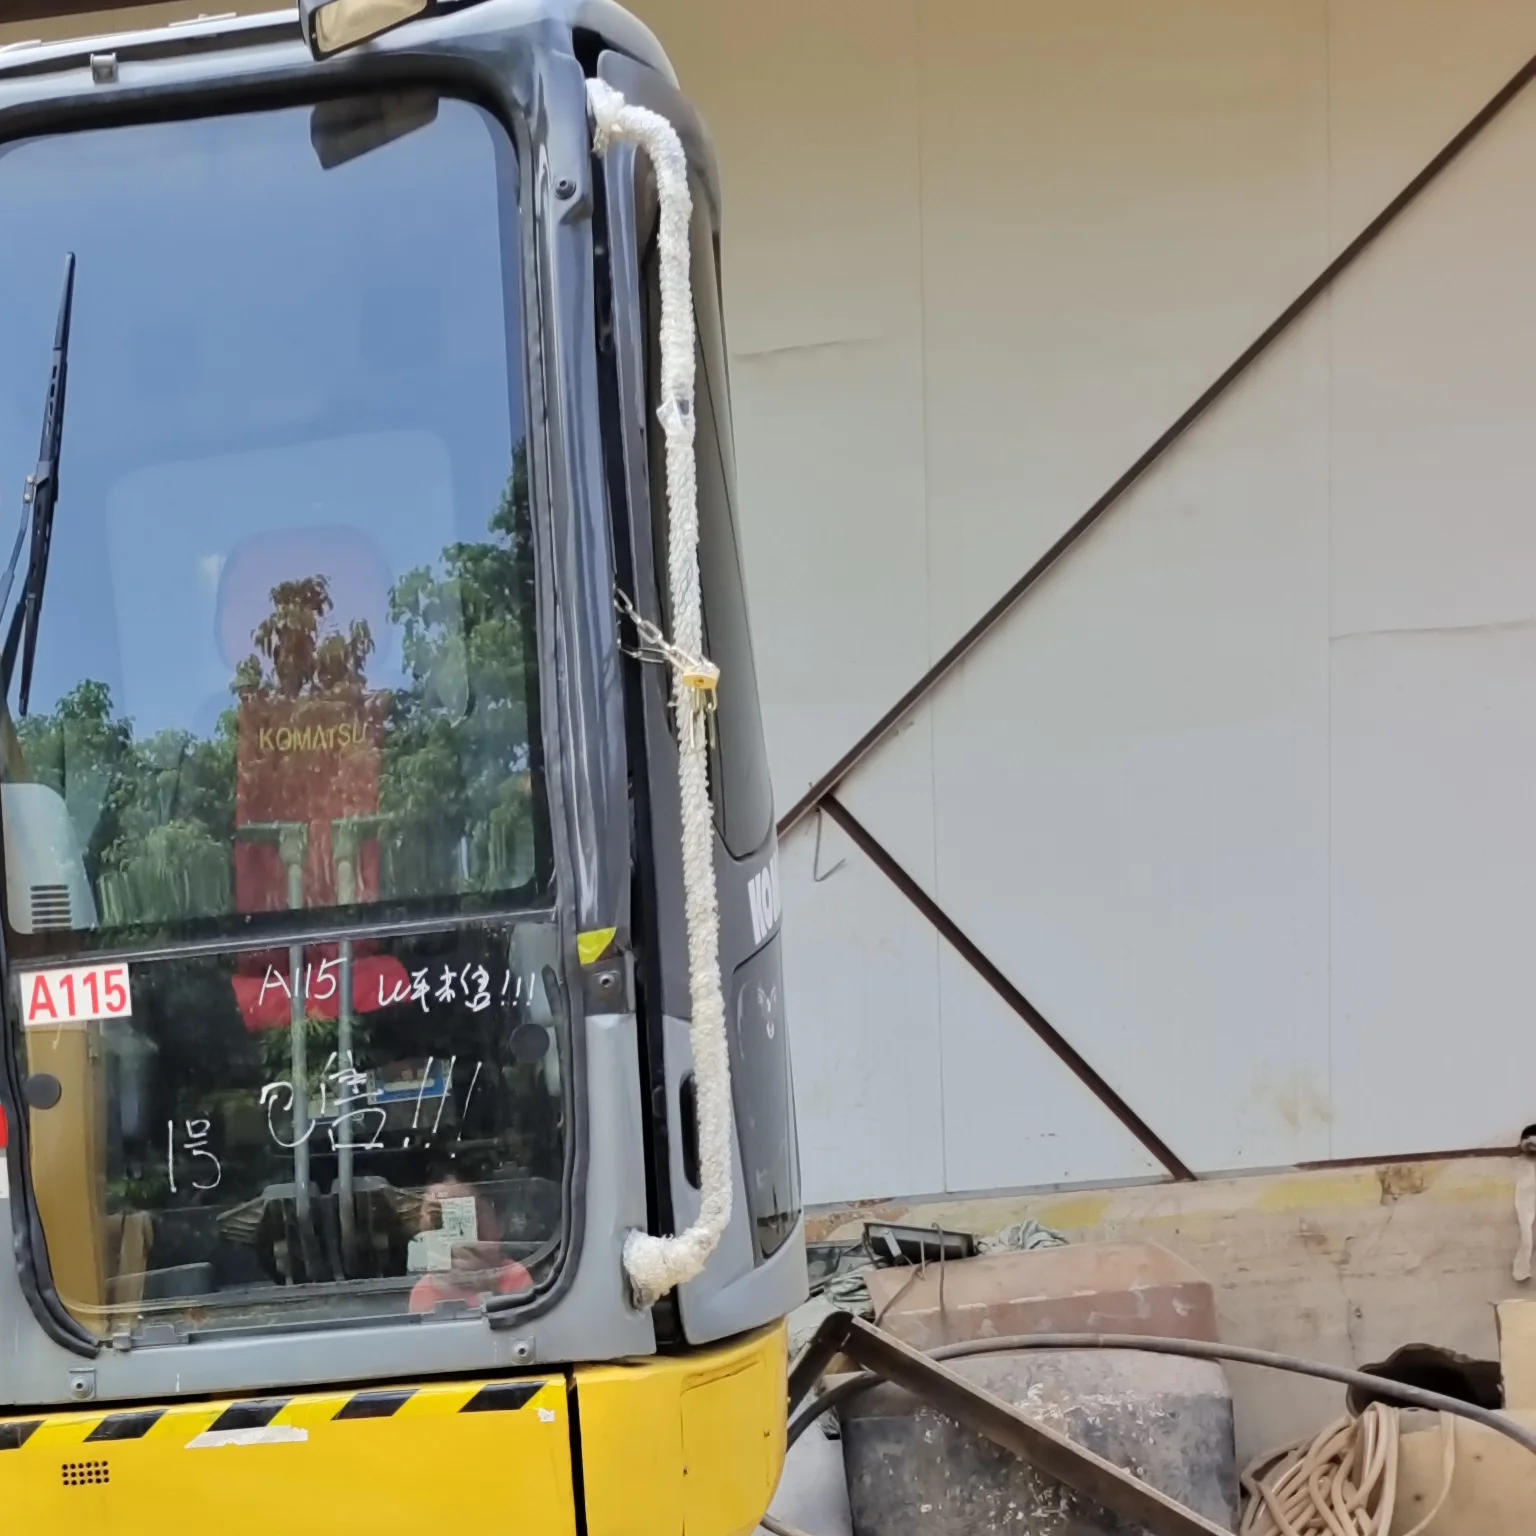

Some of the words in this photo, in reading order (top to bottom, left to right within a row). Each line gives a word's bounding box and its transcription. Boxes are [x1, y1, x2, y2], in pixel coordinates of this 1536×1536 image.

[259, 710, 367, 751] KOMATSU
[28, 968, 127, 1021] A115
[259, 957, 348, 1006] A115
